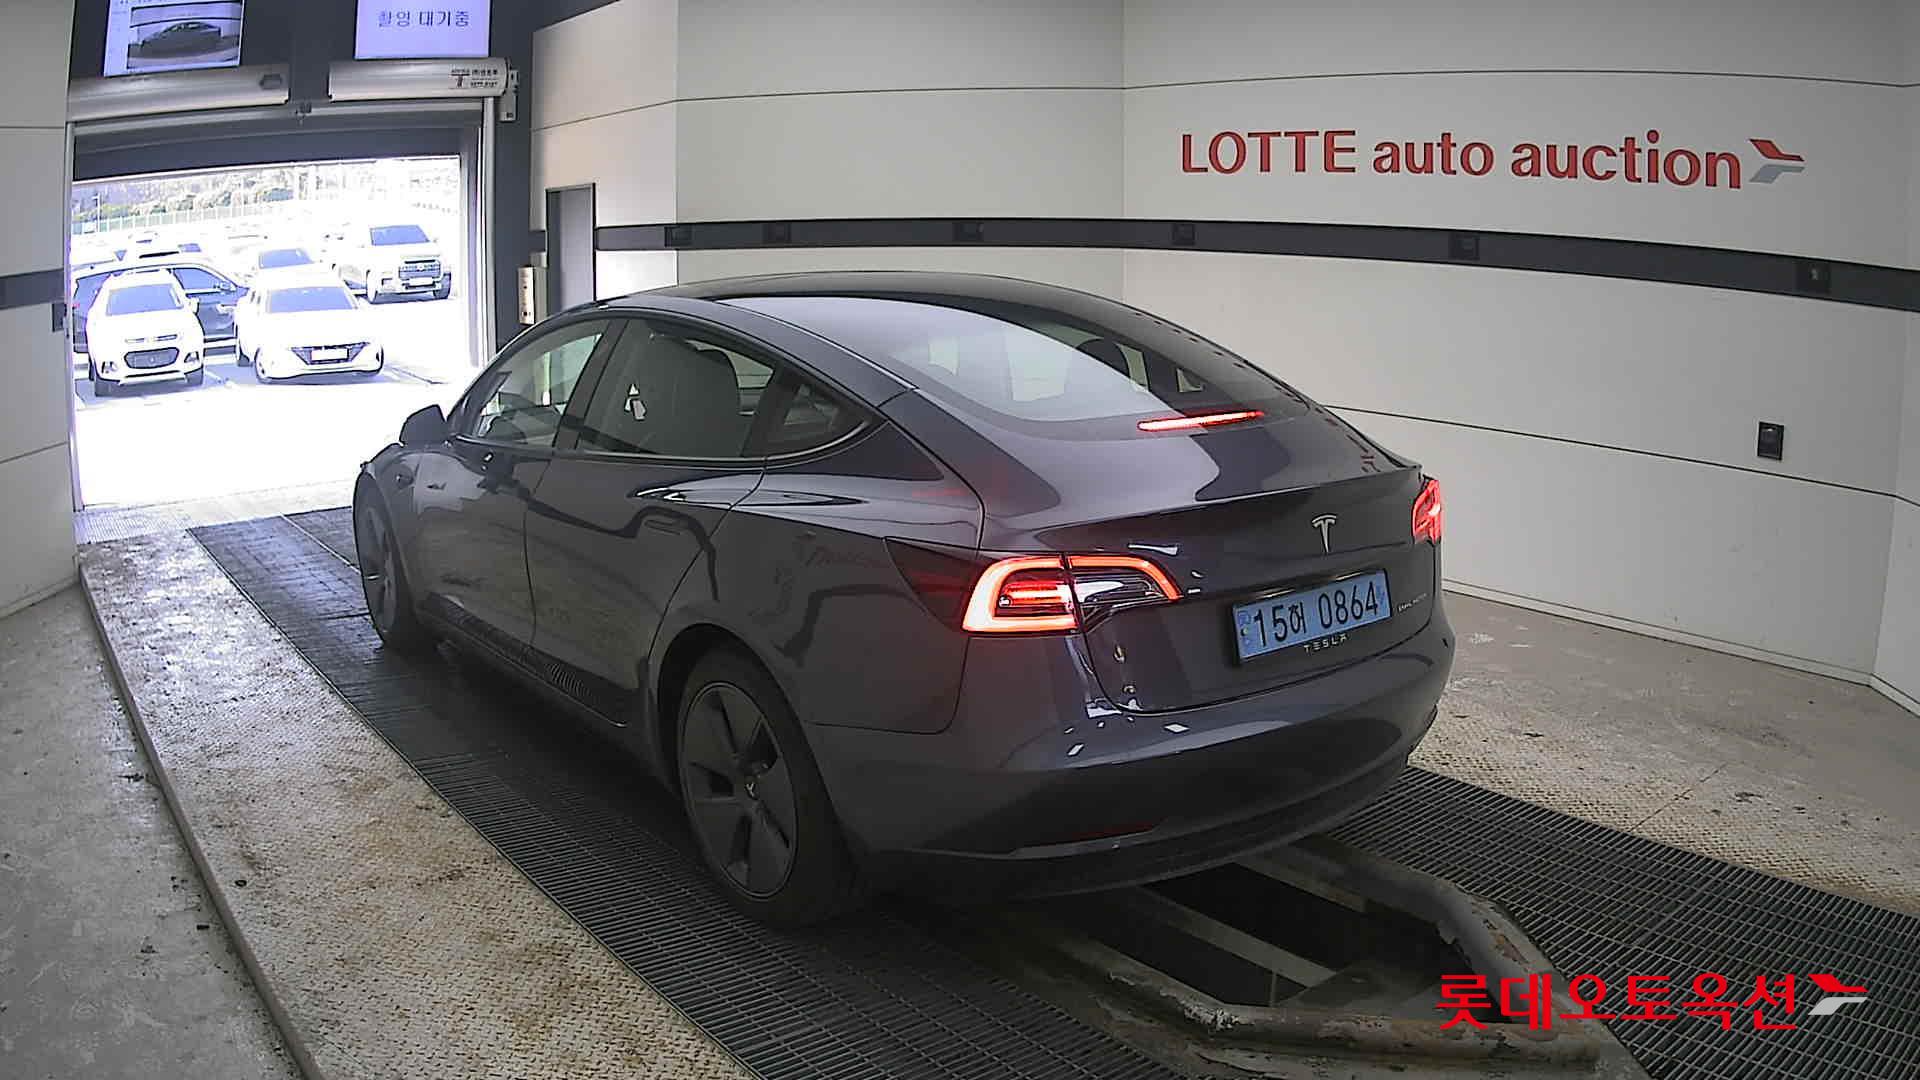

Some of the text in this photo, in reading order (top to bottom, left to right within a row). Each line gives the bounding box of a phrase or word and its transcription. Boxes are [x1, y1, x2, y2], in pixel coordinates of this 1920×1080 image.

[418, 10, 469, 27] 대기중
[1183, 130, 1742, 189] LOTTE auto auction
[1254, 581, 1379, 648] 15허 0864
[1303, 633, 1350, 654] TESLA
